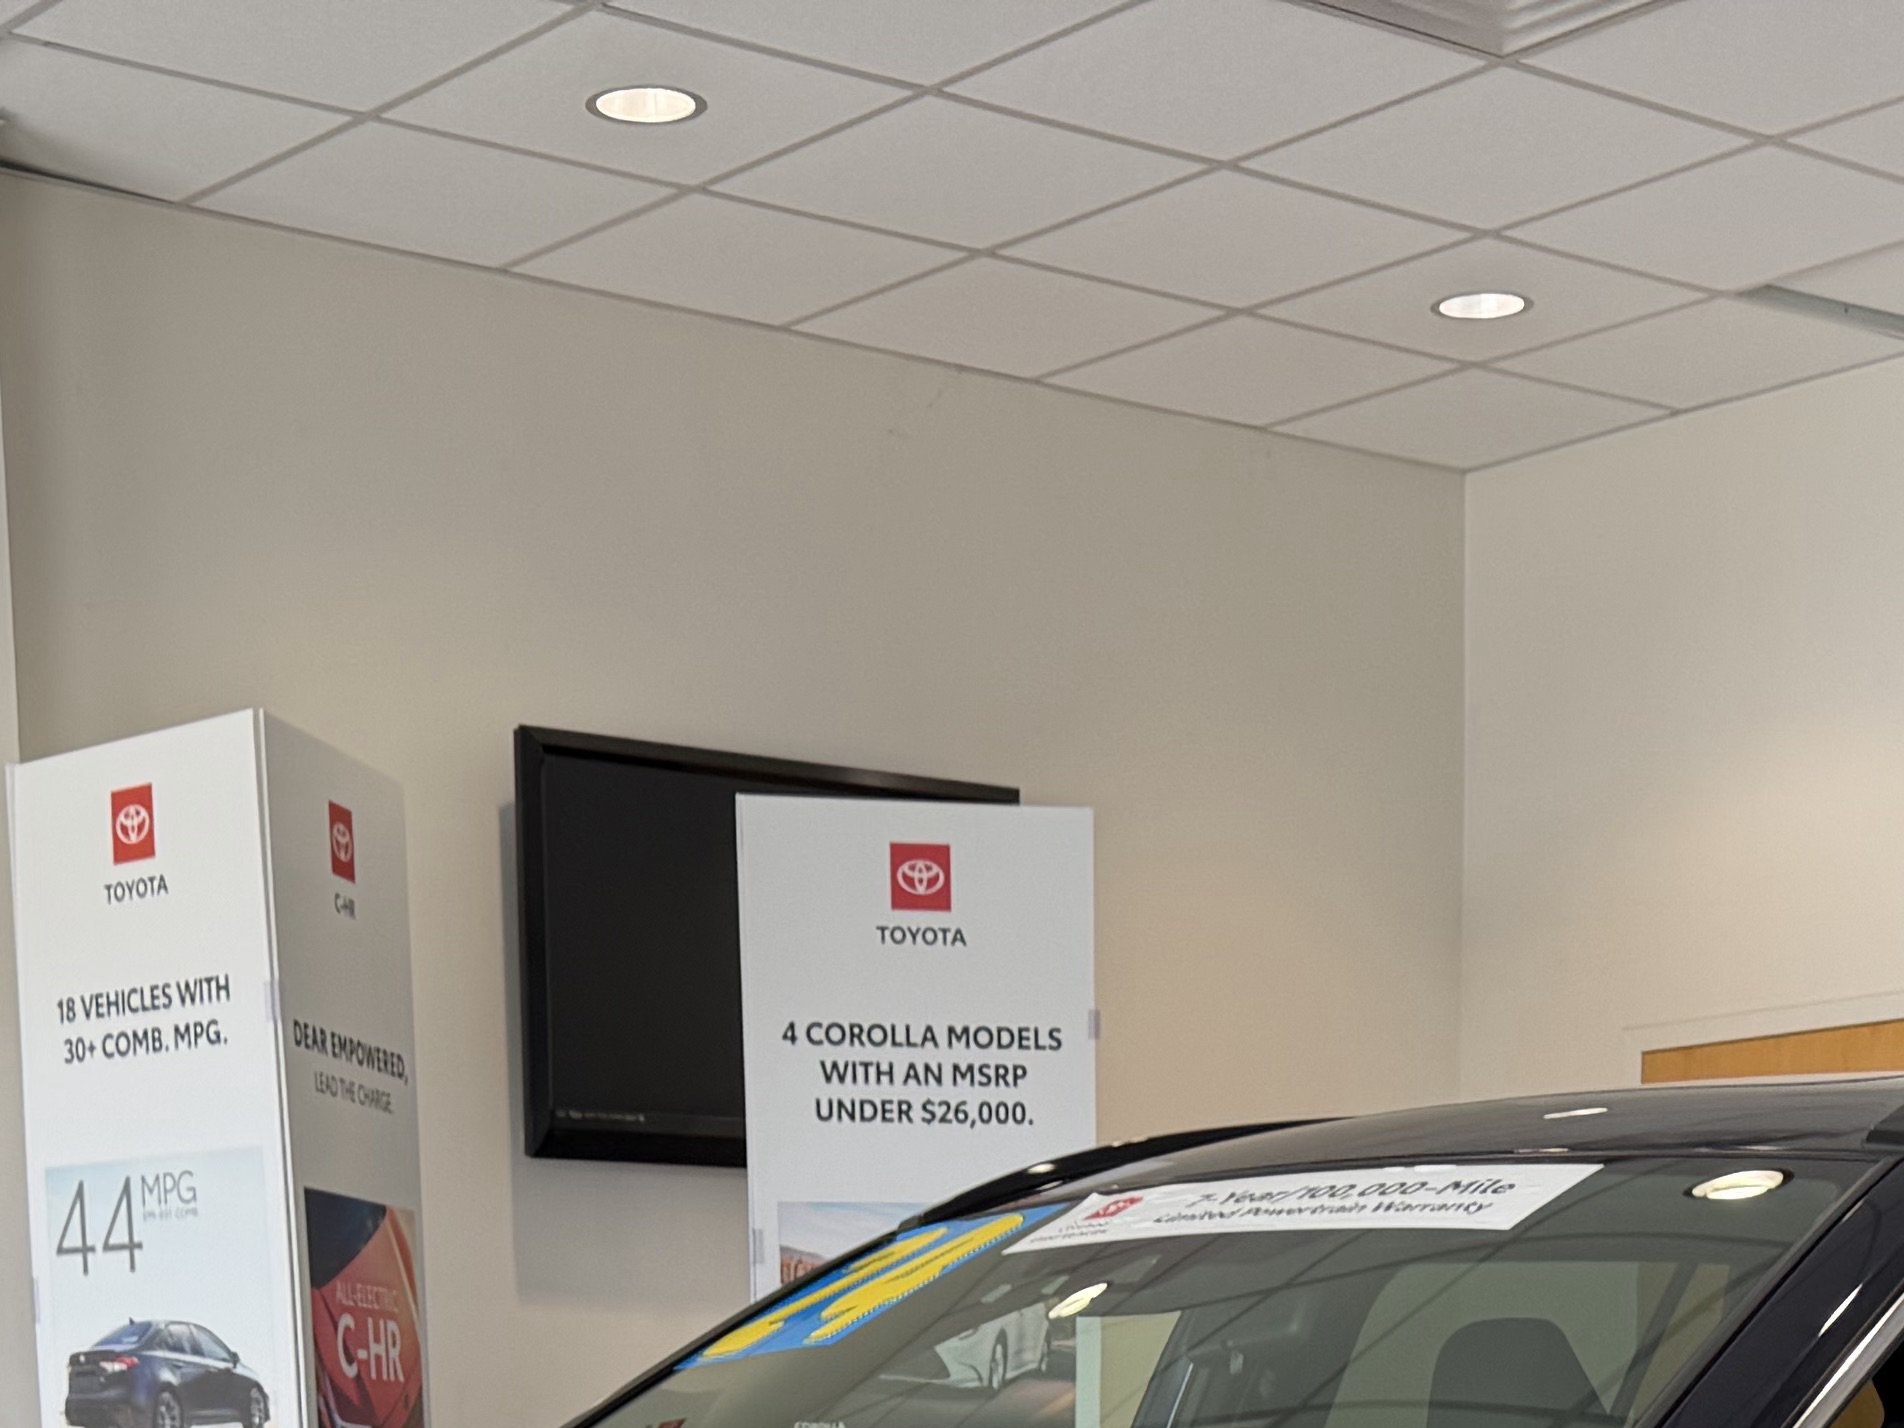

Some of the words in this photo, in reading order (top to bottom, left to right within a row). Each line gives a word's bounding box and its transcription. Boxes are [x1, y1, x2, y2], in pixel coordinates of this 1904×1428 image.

[103, 873, 169, 905] TOYOTA
[875, 925, 968, 948] TOYOTA
[56, 996, 77, 1025] 18
[80, 981, 173, 1021] VEHICLES
[176, 973, 231, 1008] WITH
[63, 1036, 97, 1064] 30+
[102, 1026, 170, 1059] COMB.
[174, 1018, 228, 1050] MPG.
[293, 1018, 328, 1056] DEAR
[330, 1030, 409, 1087] EMPOWERED,
[781, 1021, 798, 1046] 4
[805, 1021, 940, 1049] COROLLA
[947, 1025, 1063, 1052] MODELS
[819, 1059, 895, 1085] WITH
[902, 1061, 943, 1087] AN
[952, 1062, 1028, 1089] MSRP
[815, 1097, 914, 1125] UNDER
[921, 1098, 1034, 1129] $26,000.
[55, 1175, 144, 1277] 44
[140, 1169, 198, 1207] MPG
[1369, 1200, 1495, 1216] Warranty
[336, 1312, 406, 1383] C-HR
